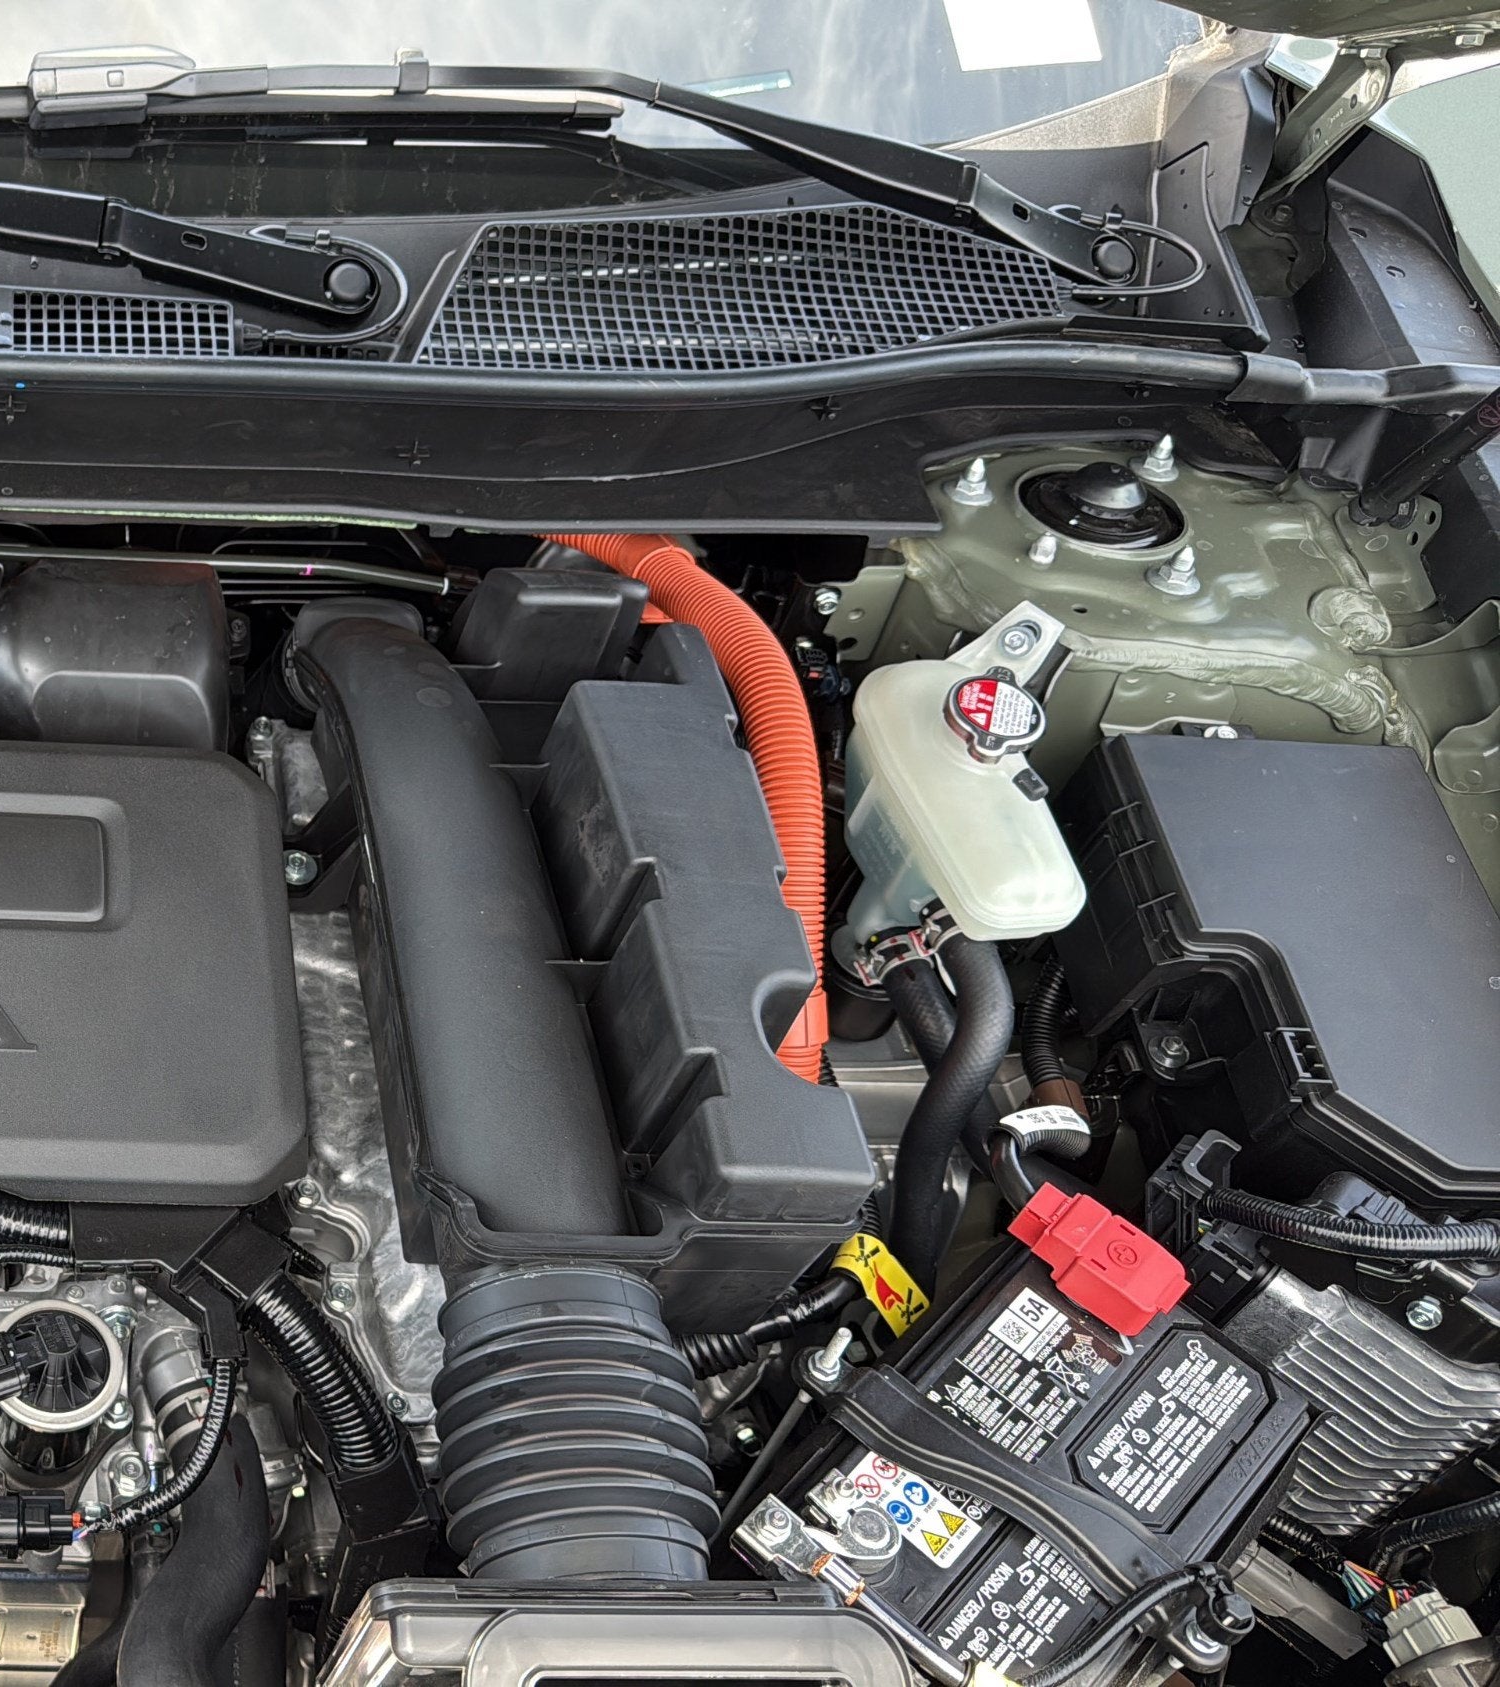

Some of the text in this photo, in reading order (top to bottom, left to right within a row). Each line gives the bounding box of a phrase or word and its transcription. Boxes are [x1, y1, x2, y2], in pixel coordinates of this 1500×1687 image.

[1018, 1293, 1049, 1323] 5A
[1029, 1334, 1047, 1353] GROUP
[1075, 1379, 1091, 1394] Pb
[996, 1620, 1010, 1634] NO
